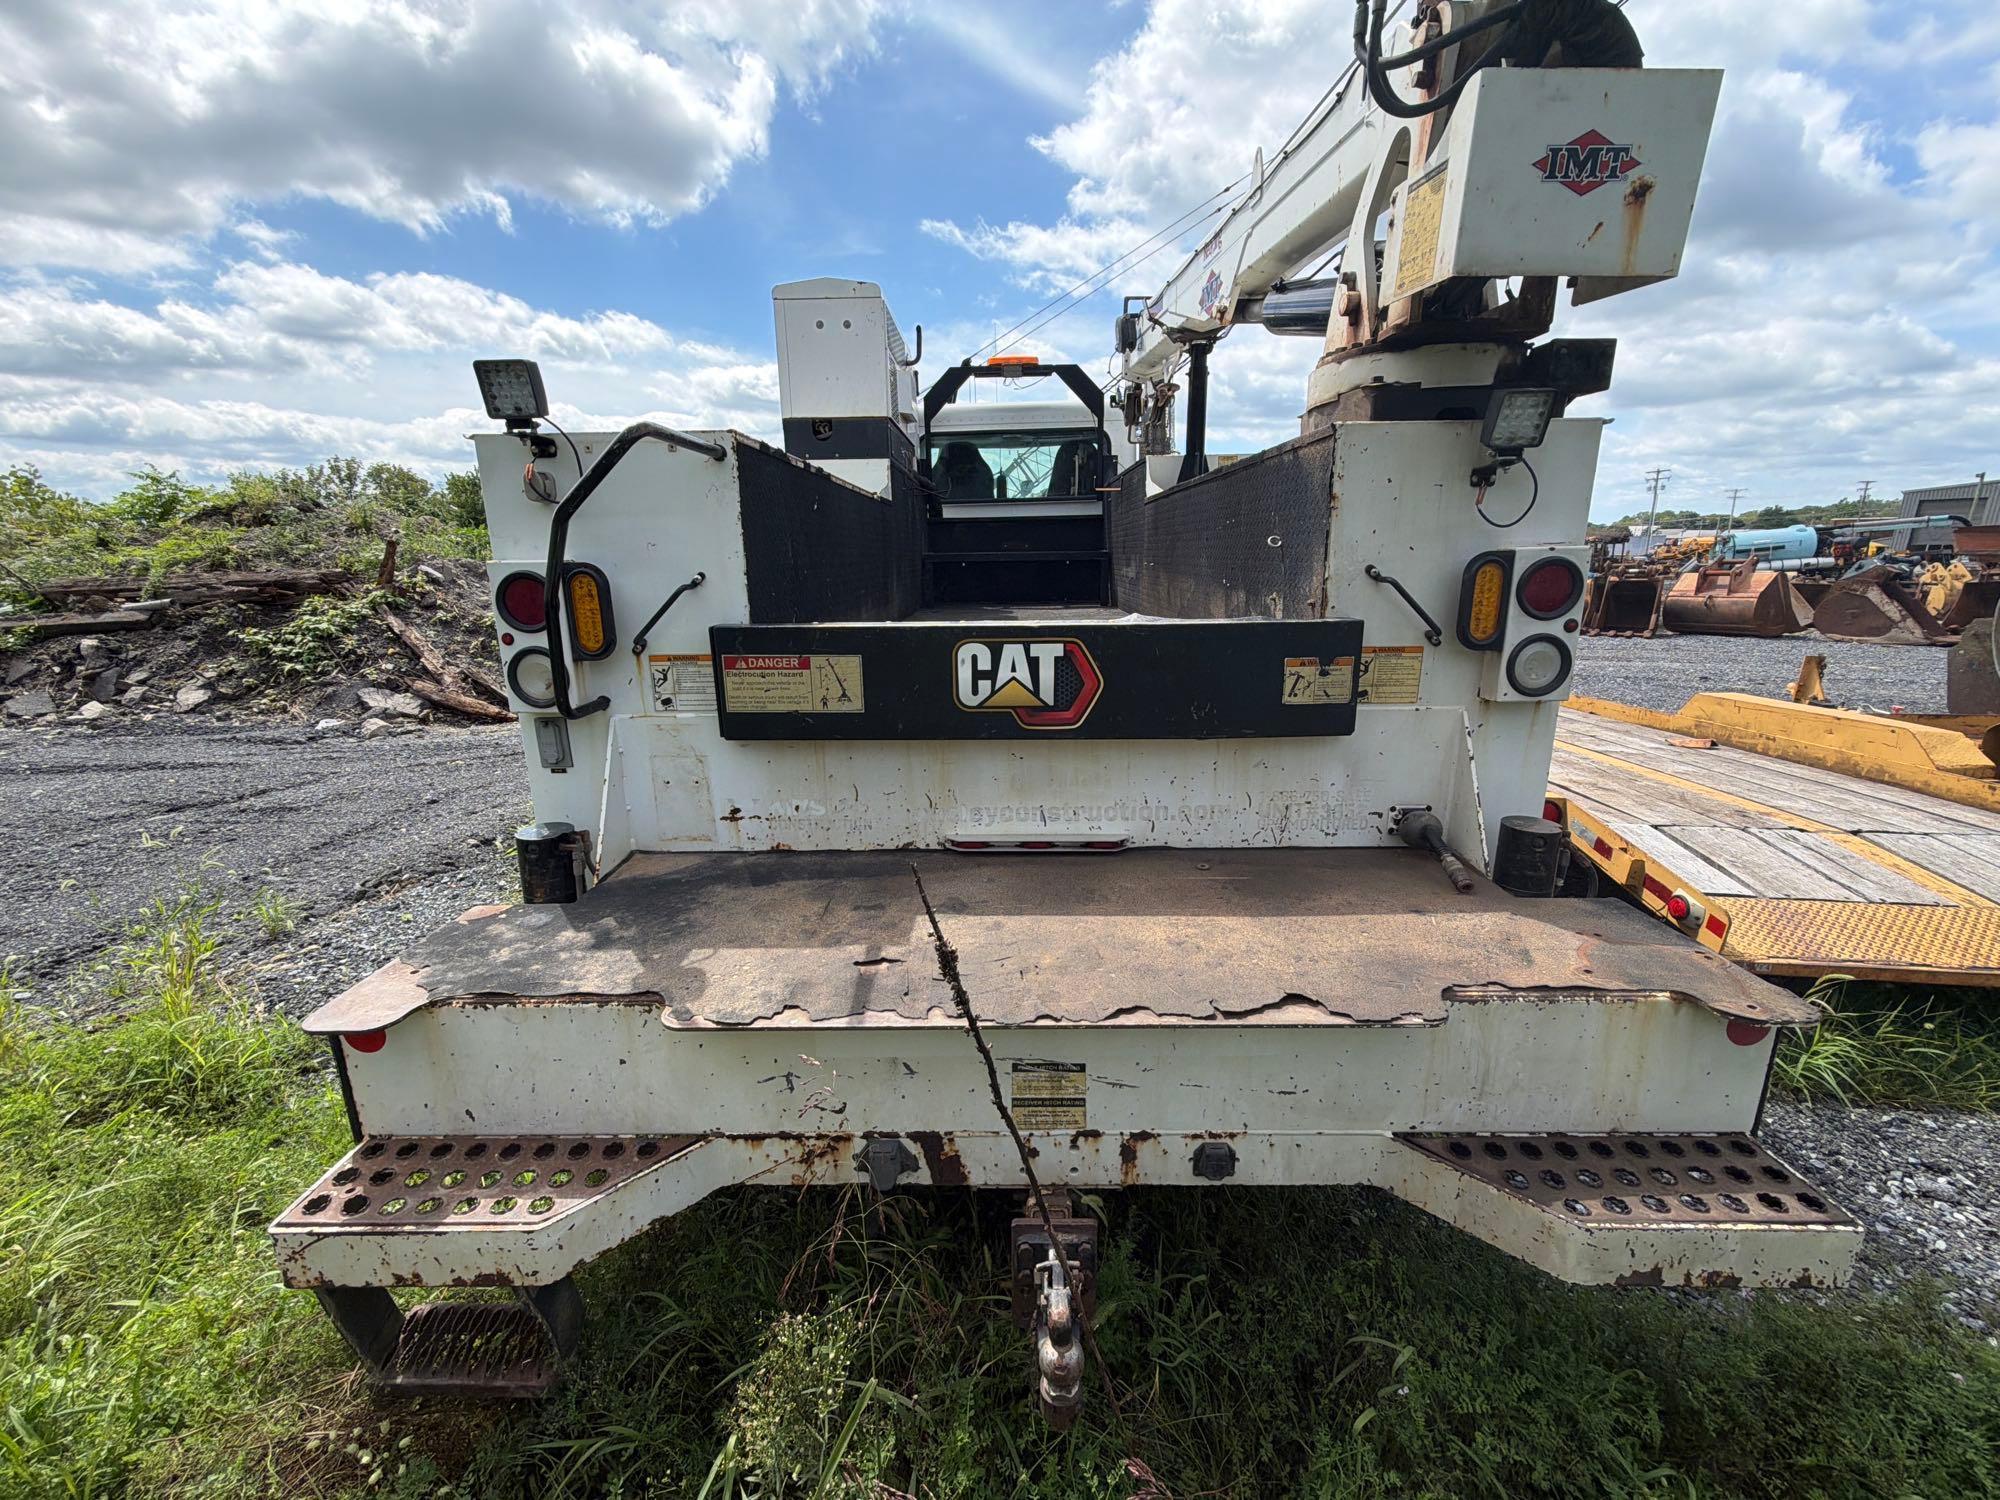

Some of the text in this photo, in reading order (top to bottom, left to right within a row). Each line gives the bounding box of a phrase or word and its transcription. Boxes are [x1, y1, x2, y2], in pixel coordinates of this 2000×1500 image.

[1542, 145, 1632, 182] IMT
[748, 658, 800, 668] DANGER
[957, 642, 1064, 707] CAT
